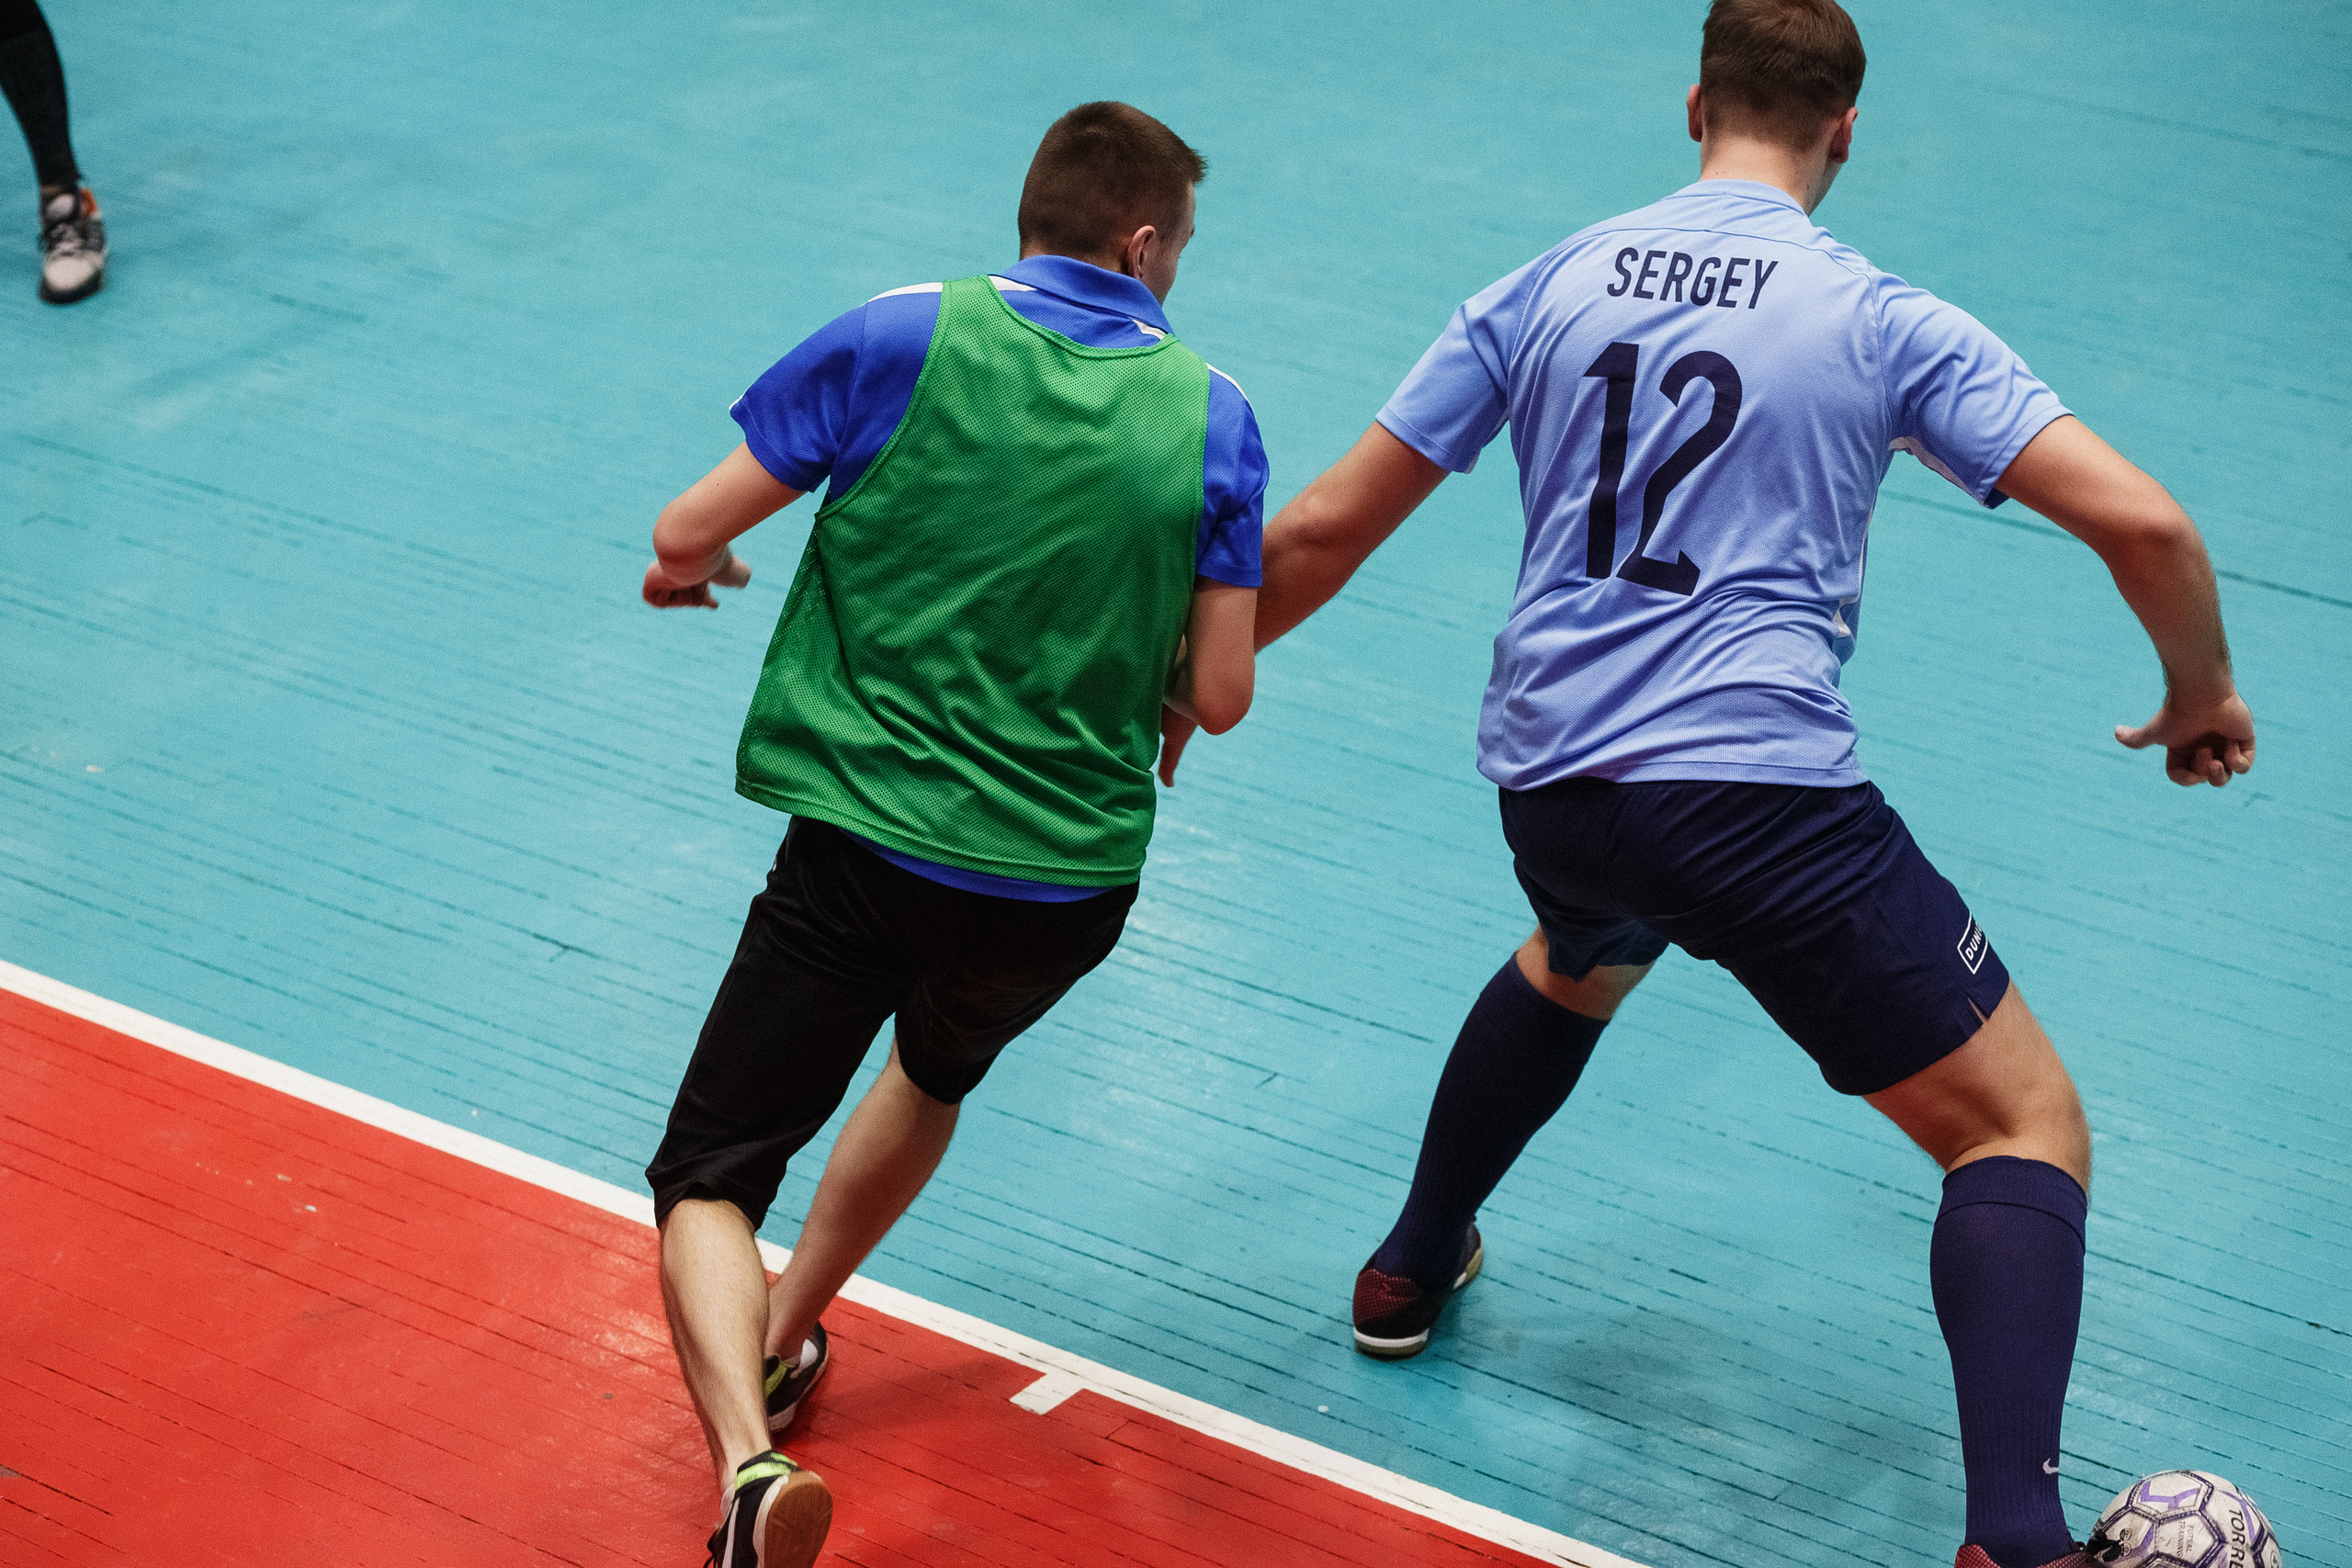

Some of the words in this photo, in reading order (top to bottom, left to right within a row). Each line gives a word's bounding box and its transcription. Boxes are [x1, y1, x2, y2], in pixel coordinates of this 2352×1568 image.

[1607, 246, 1779, 310] SERGEY
[1582, 341, 1743, 597] 12
[2177, 1521, 2186, 1557] TRAINING
[2186, 1525, 2195, 1552] FUTSAL
